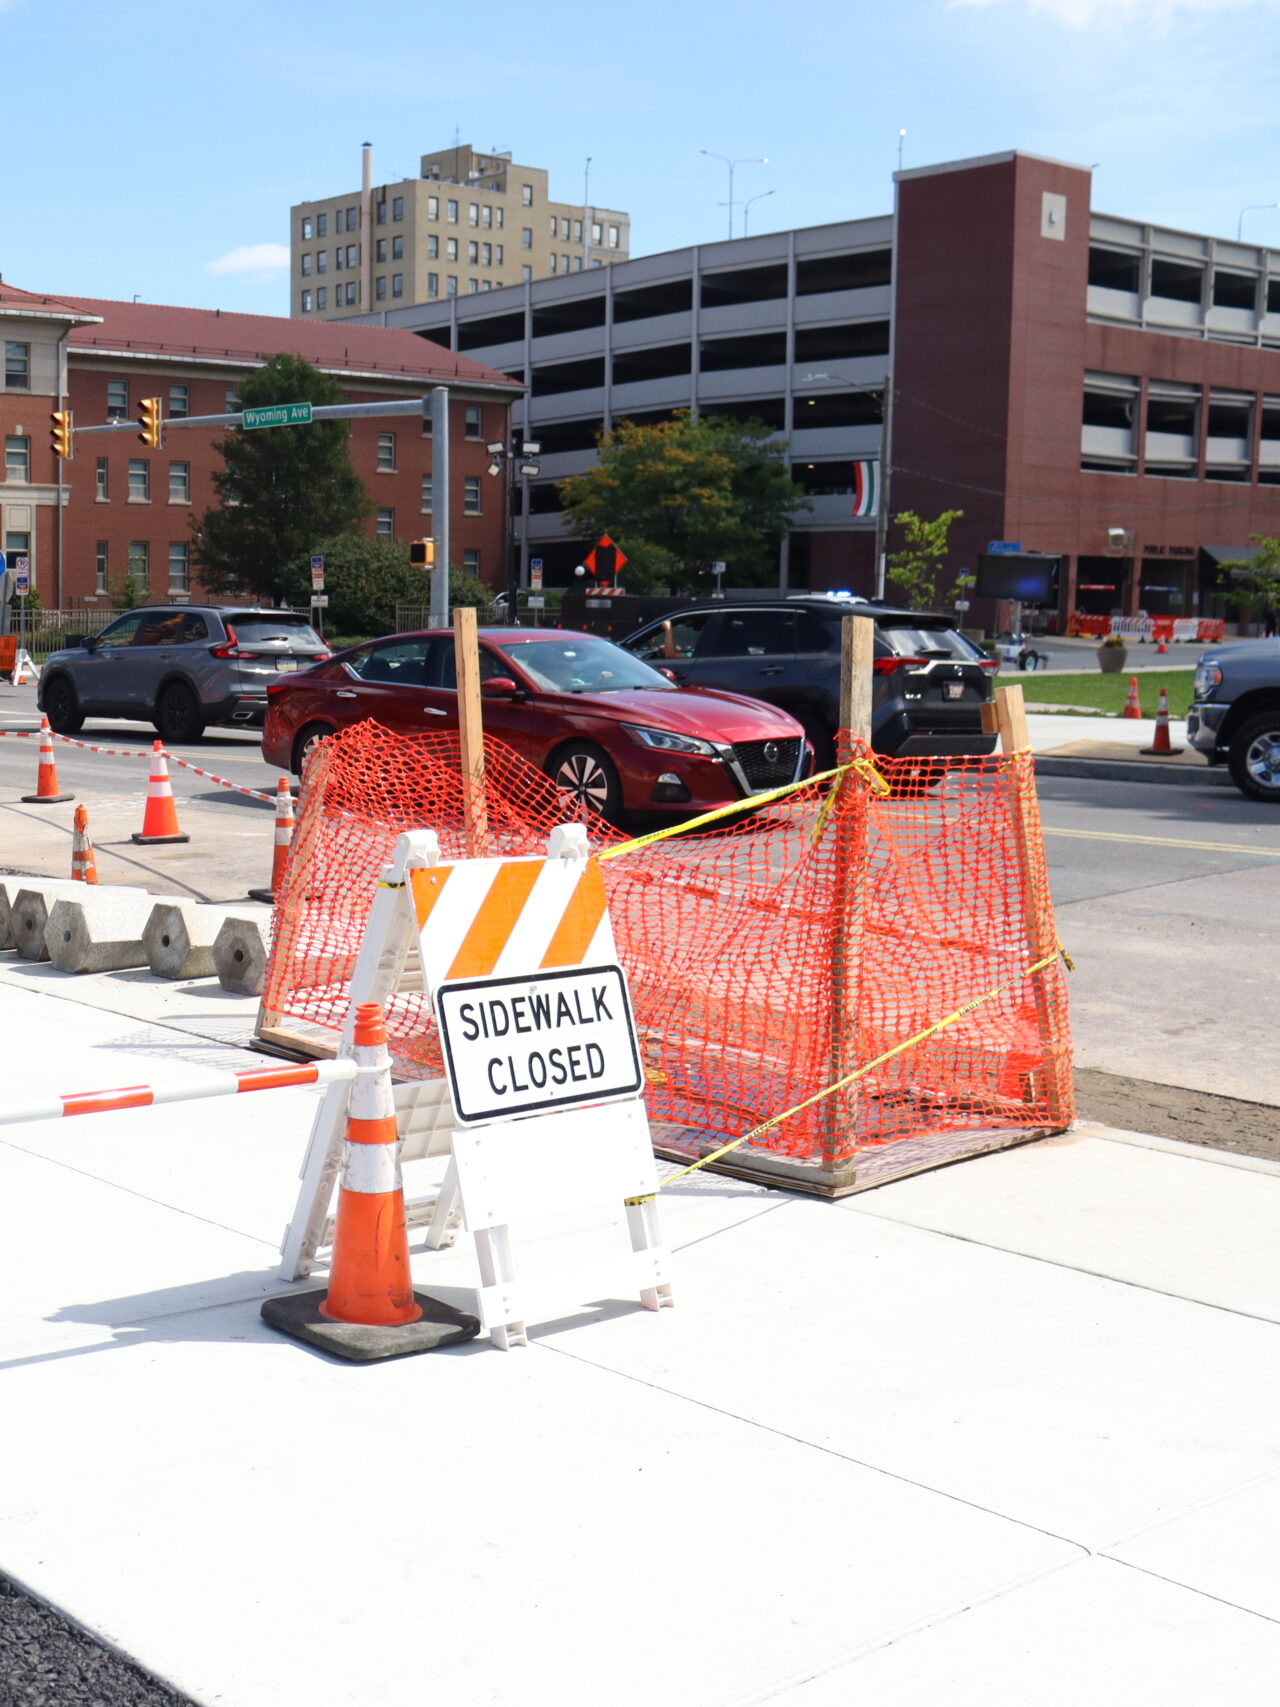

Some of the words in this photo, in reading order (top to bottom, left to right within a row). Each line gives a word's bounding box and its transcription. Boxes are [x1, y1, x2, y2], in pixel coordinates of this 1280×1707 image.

[246, 408, 288, 425] Wyoming
[291, 407, 308, 418] Ave
[459, 985, 613, 1041] SIDEWALK
[487, 1042, 606, 1096] CLOSED
